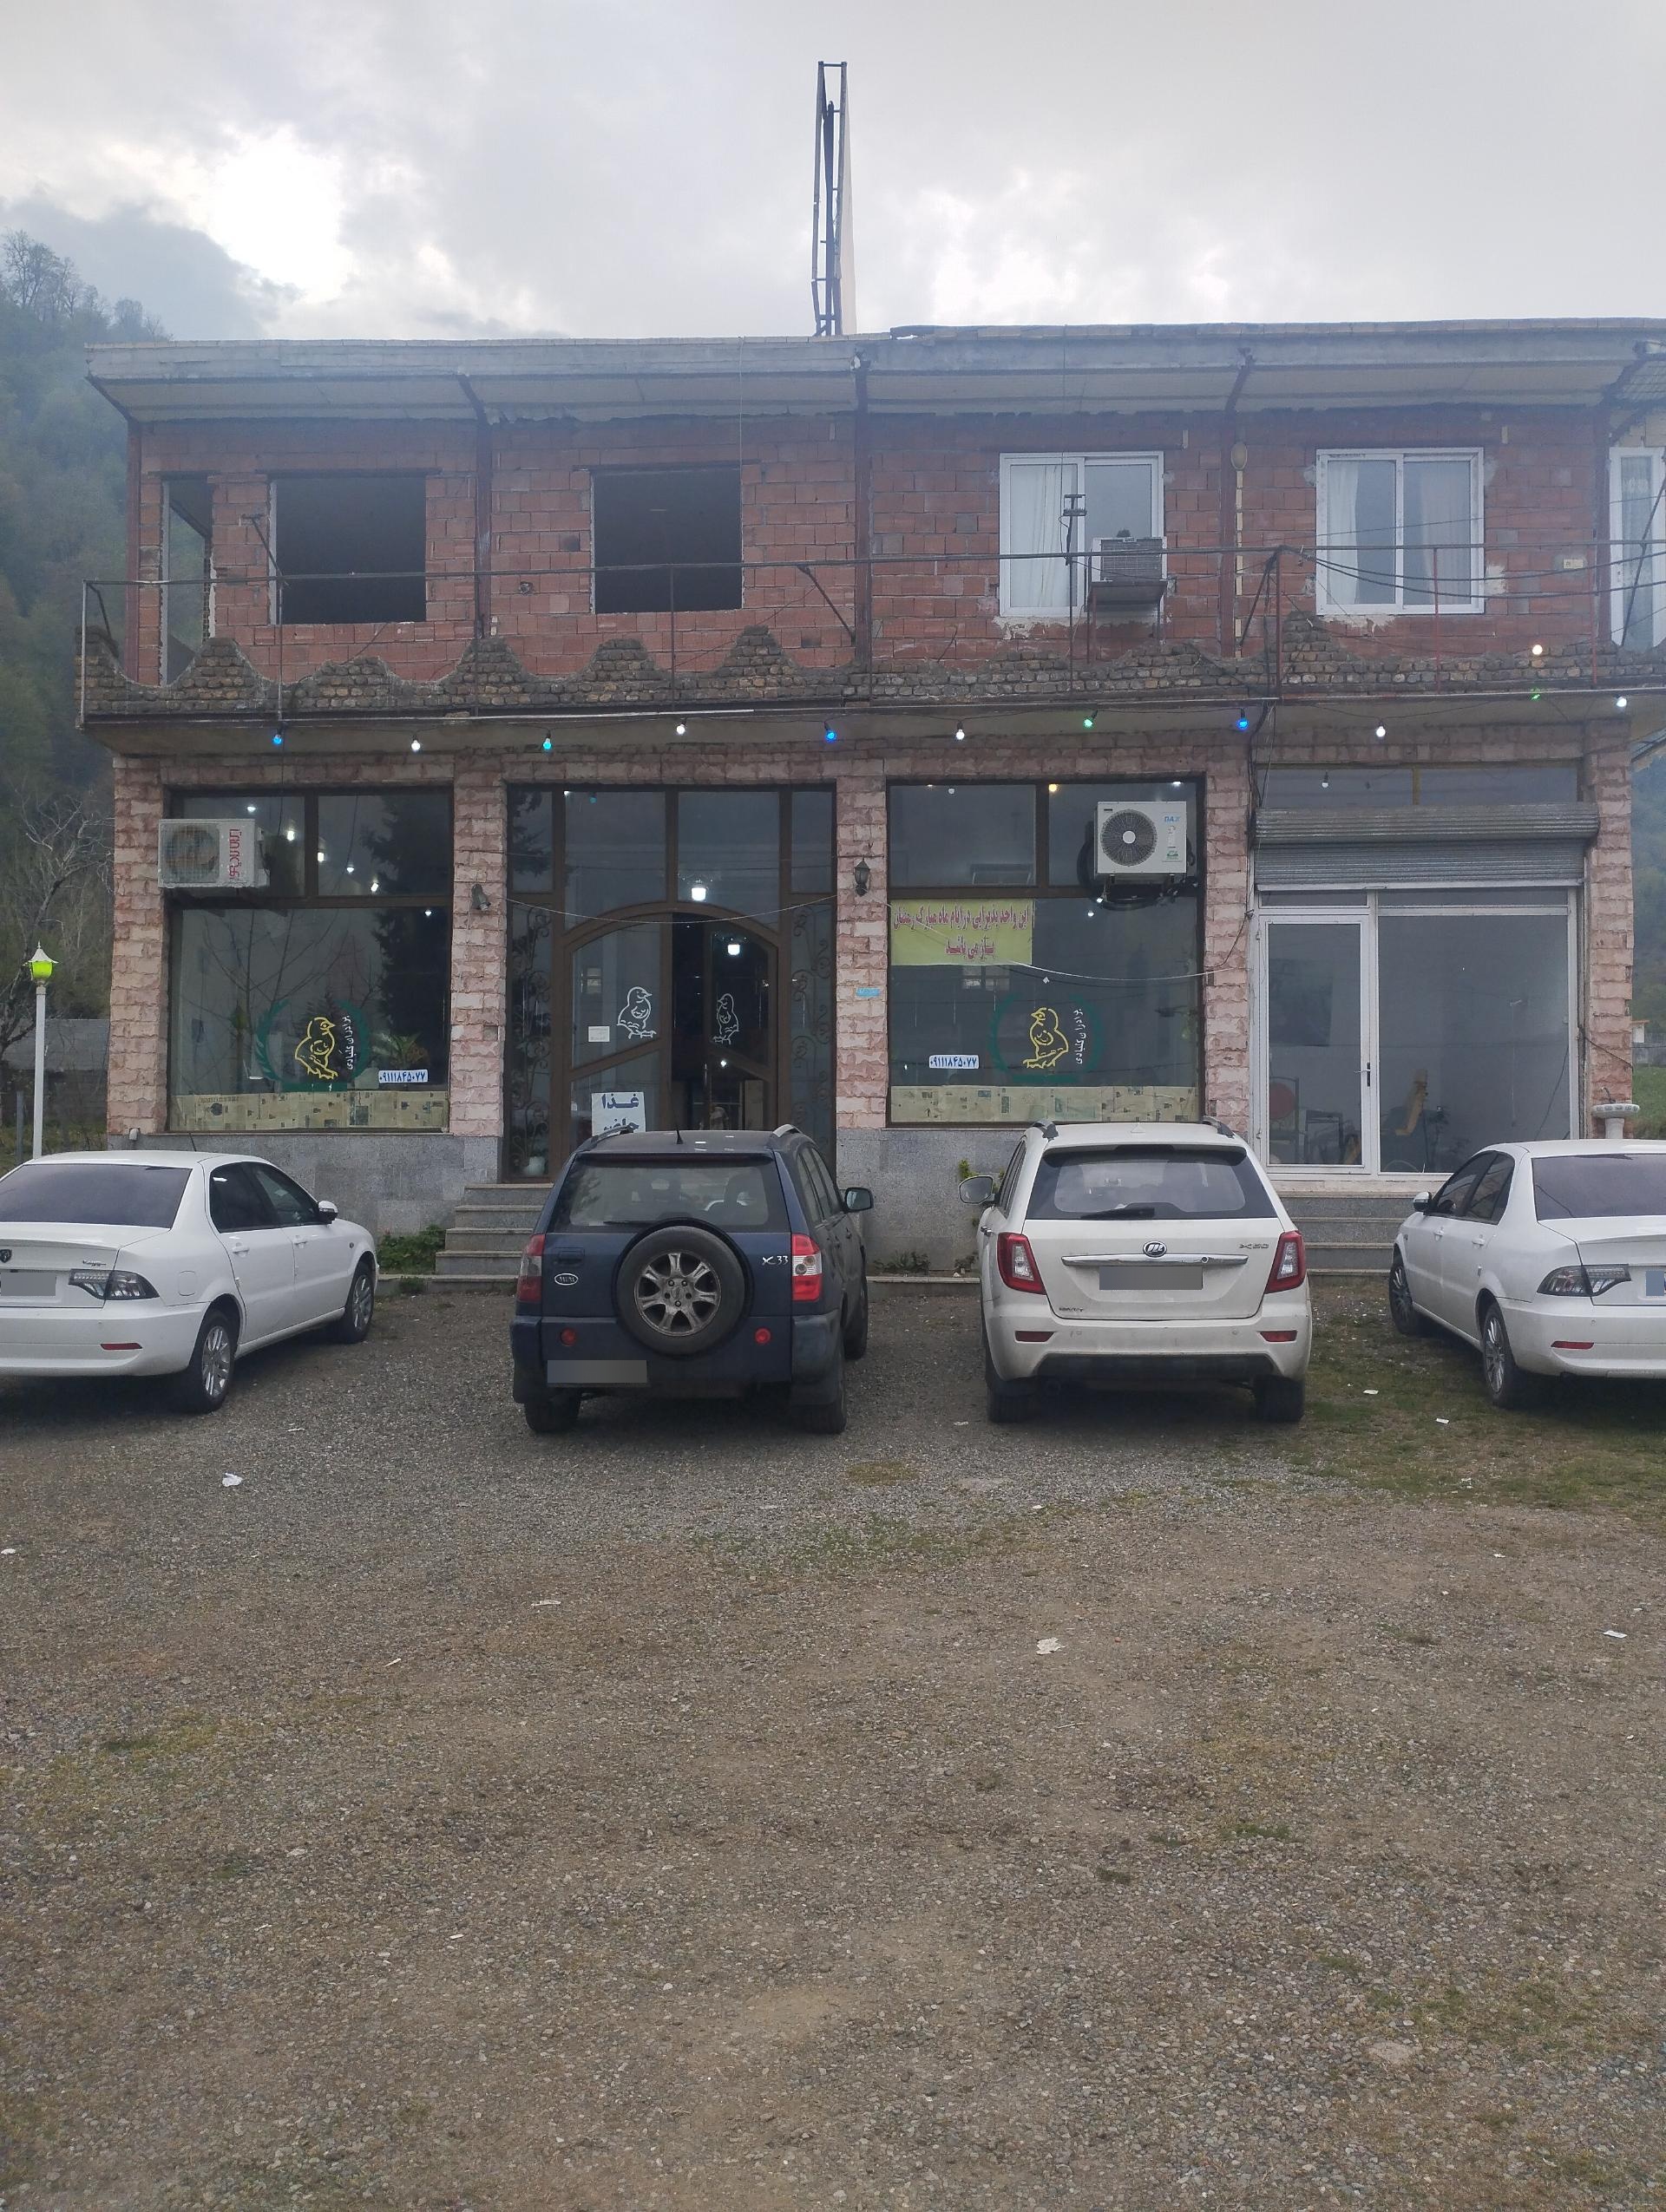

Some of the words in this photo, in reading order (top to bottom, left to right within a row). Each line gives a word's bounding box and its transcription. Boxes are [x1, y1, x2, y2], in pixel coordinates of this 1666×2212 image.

[894, 906, 915, 931] رمضان
[915, 905, 936, 930] مبارک
[938, 904, 949, 924] ماه
[950, 905, 962, 929] ایام
[962, 909, 971, 930] در
[972, 904, 999, 930] پذیرایی
[1000, 905, 1017, 930] واحد
[1018, 905, 1029, 930] این
[945, 935, 967, 959] باشد
[967, 943, 978, 960] می
[980, 934, 994, 960] باز
[342, 1015, 354, 1044] برادران
[1073, 1008, 1086, 1039] برادران
[601, 1093, 639, 1109] غذا
[762, 1255, 789, 1265] X33
